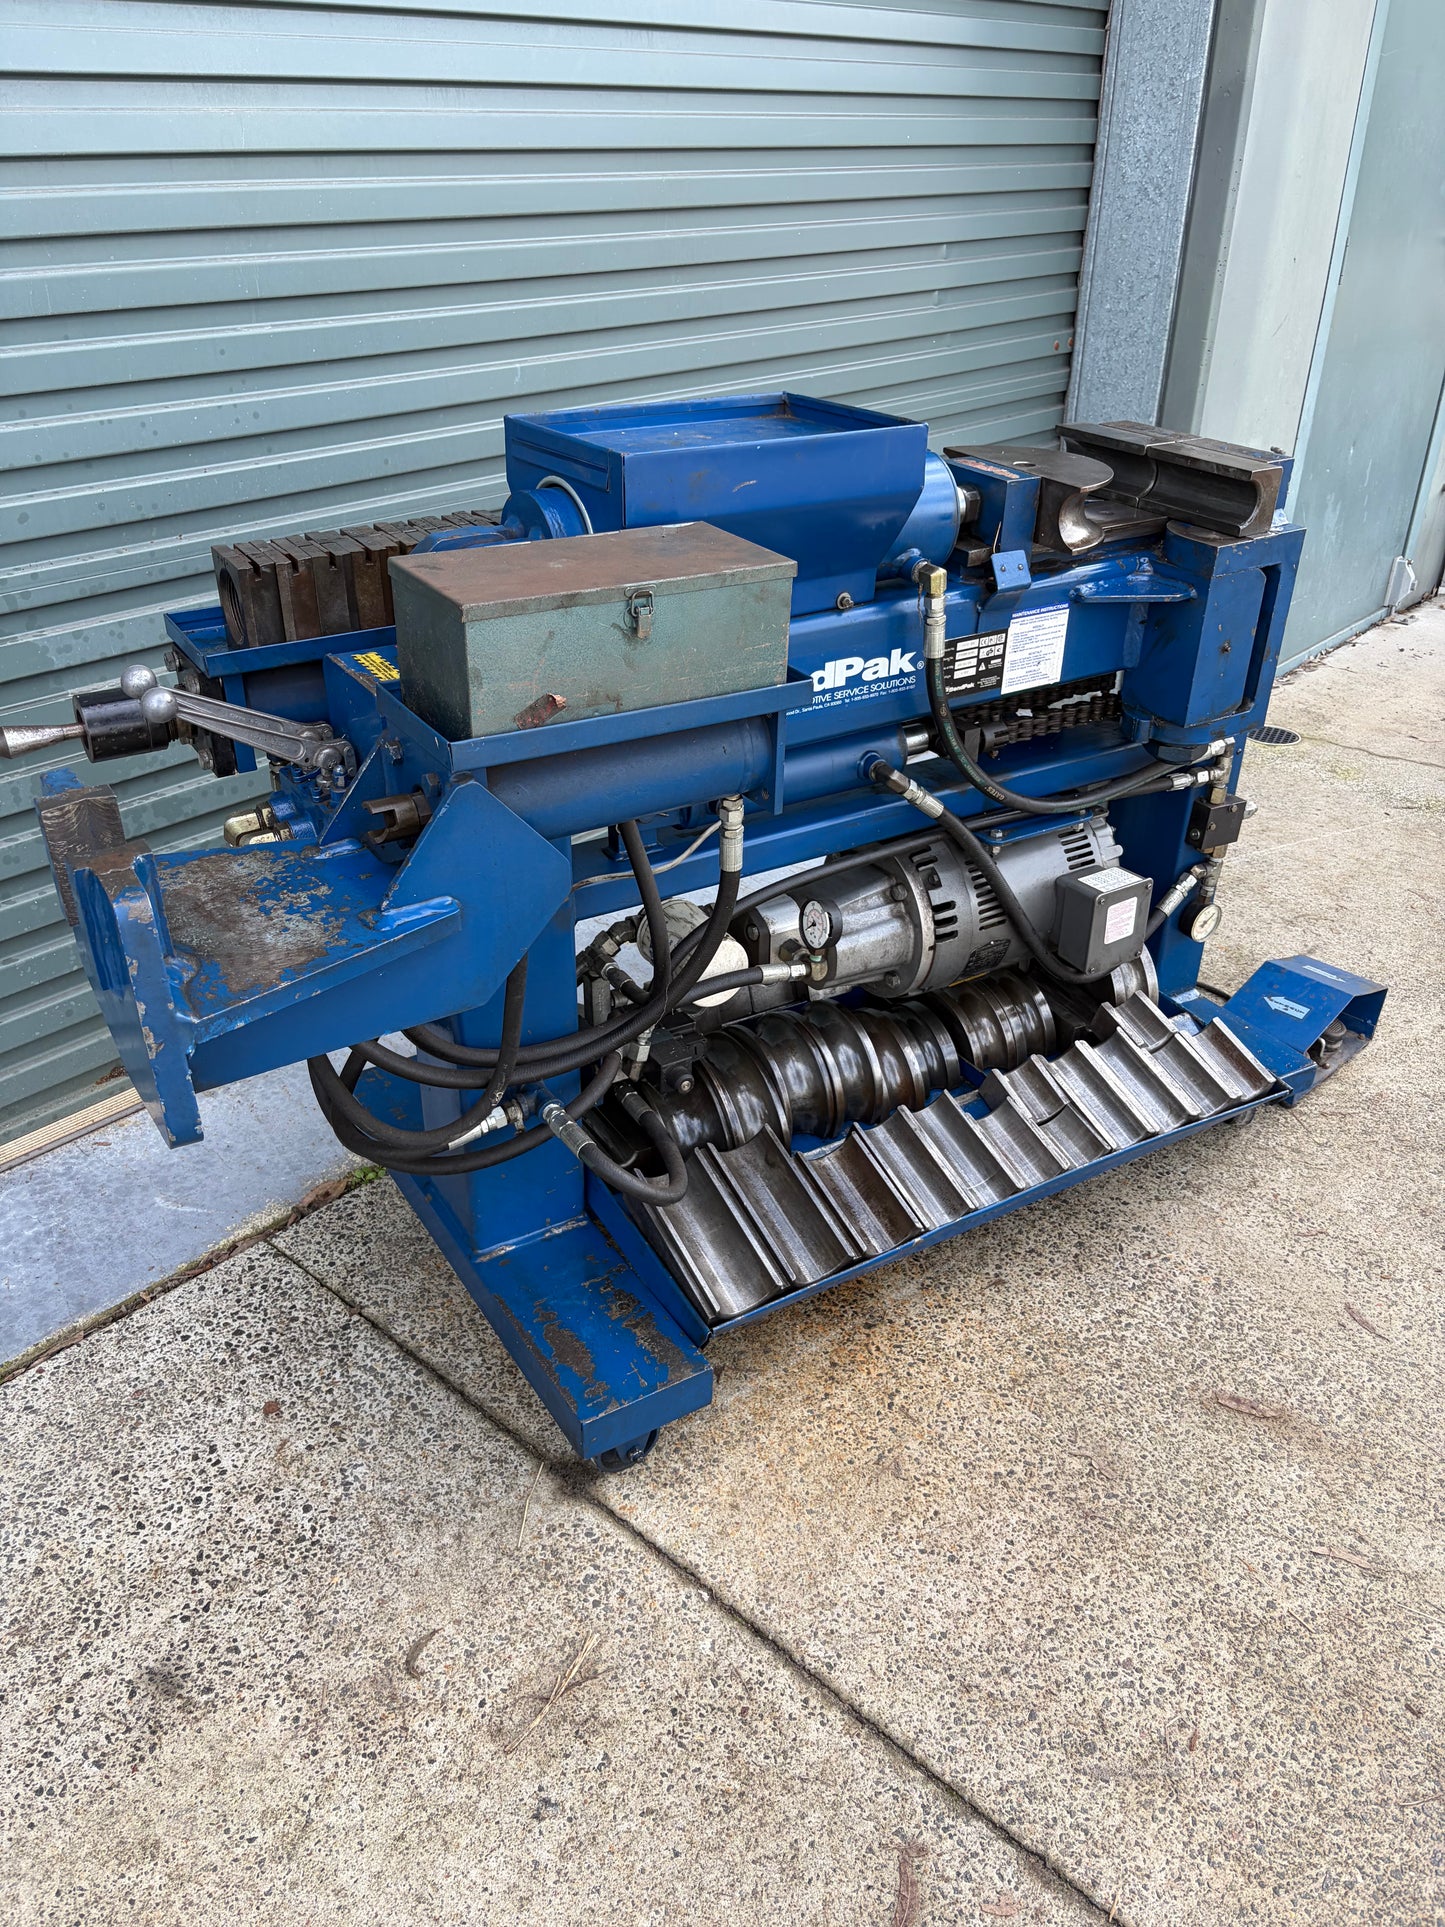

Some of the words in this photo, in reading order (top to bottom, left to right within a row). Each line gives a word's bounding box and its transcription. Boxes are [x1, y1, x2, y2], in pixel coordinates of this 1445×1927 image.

[1040, 603, 1069, 613] INSTRUCTIONS
[833, 685, 869, 700] SERVICE
[870, 676, 916, 693] SOLUTIONS
